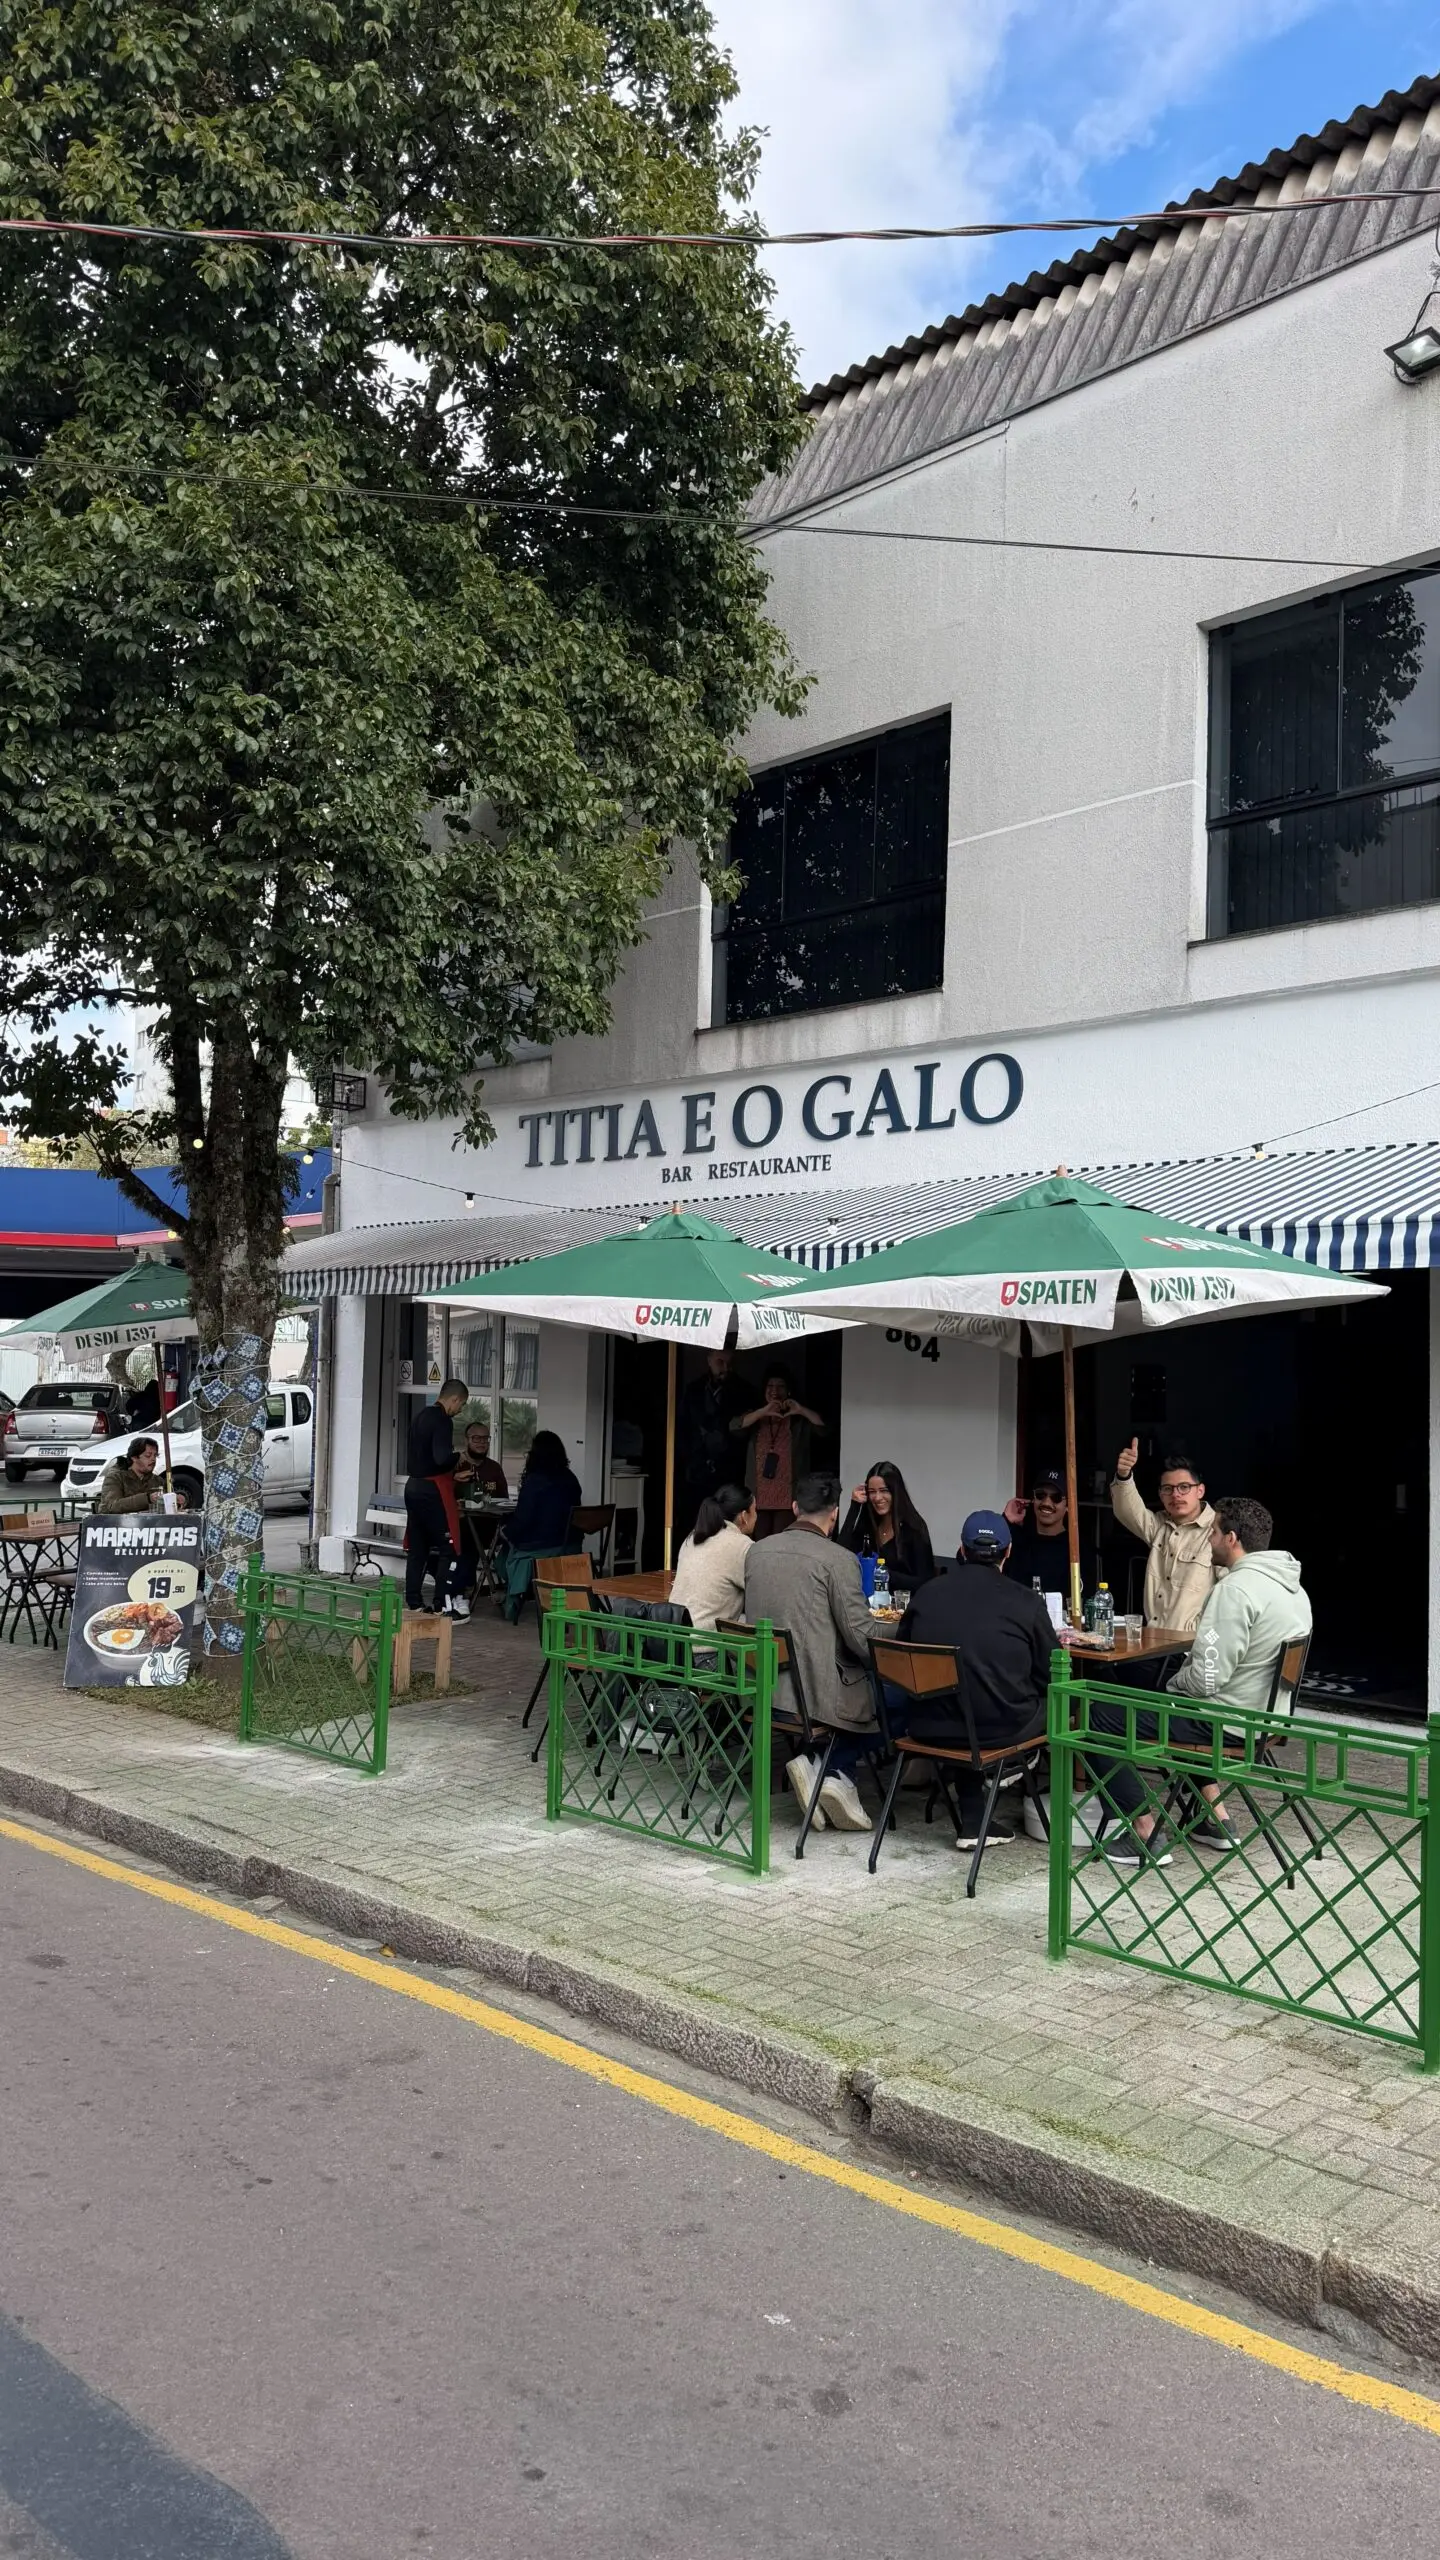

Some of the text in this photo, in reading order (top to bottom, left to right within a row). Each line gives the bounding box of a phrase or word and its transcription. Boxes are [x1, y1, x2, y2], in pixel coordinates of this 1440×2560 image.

[519, 1053, 1024, 1168] TITIA E O GALO
[661, 1154, 832, 1184] BAR RESTAURANTE
[1018, 1278, 1097, 1305] SPATEN
[1201, 1276, 1236, 1301] 1397
[650, 1306, 713, 1328] SPATEN
[75, 1326, 119, 1350] DESDE
[125, 1326, 157, 1343] 1397
[85, 1526, 199, 1547] MARMITAS
[114, 1548, 167, 1556] DELIVERY
[147, 1577, 172, 1599] 19
[1204, 1645, 1220, 1695] Colum
